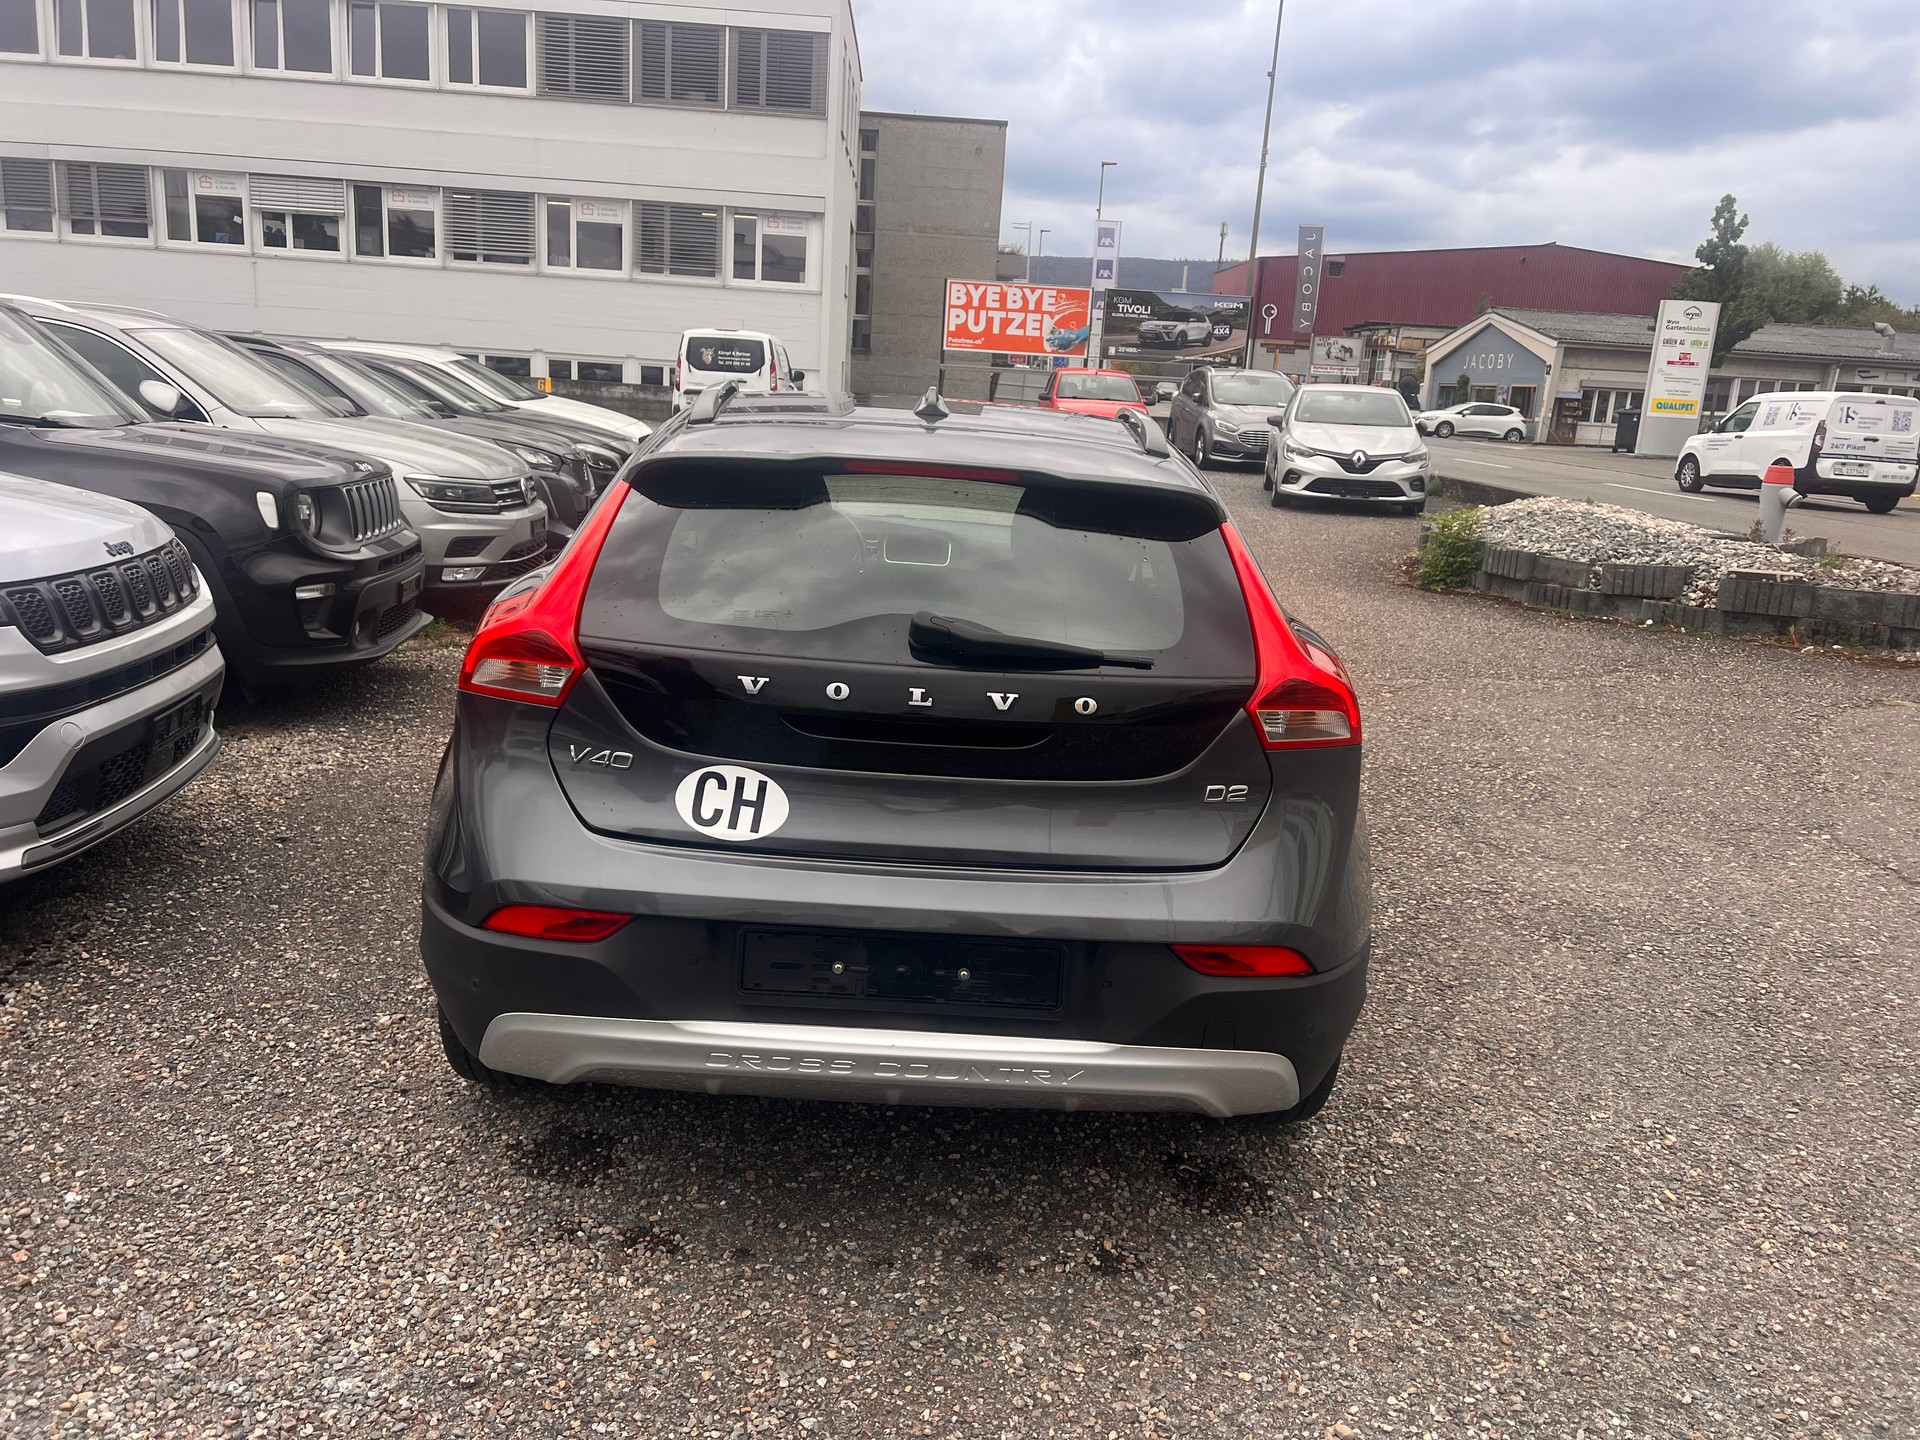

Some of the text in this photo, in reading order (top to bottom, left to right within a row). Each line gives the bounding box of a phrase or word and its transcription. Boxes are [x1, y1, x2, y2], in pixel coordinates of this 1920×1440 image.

[950, 283, 1058, 312] BYE BYE
[1113, 295, 1132, 304] KGM
[1214, 301, 1244, 310] KGM
[1117, 303, 1151, 315] TIVOLI
[1463, 353, 1515, 369] JACOBY
[537, 378, 545, 392] 6
[1656, 401, 1694, 412] QUALIPET
[1830, 442, 1866, 451] 24/7 Pikett
[103, 540, 135, 557] Jeep
[737, 675, 1098, 715] VOLVO
[569, 744, 635, 770] V40
[1202, 783, 1249, 803] D2
[691, 770, 769, 834] CH
[705, 1052, 1086, 1086] CROSS COUNTRY
